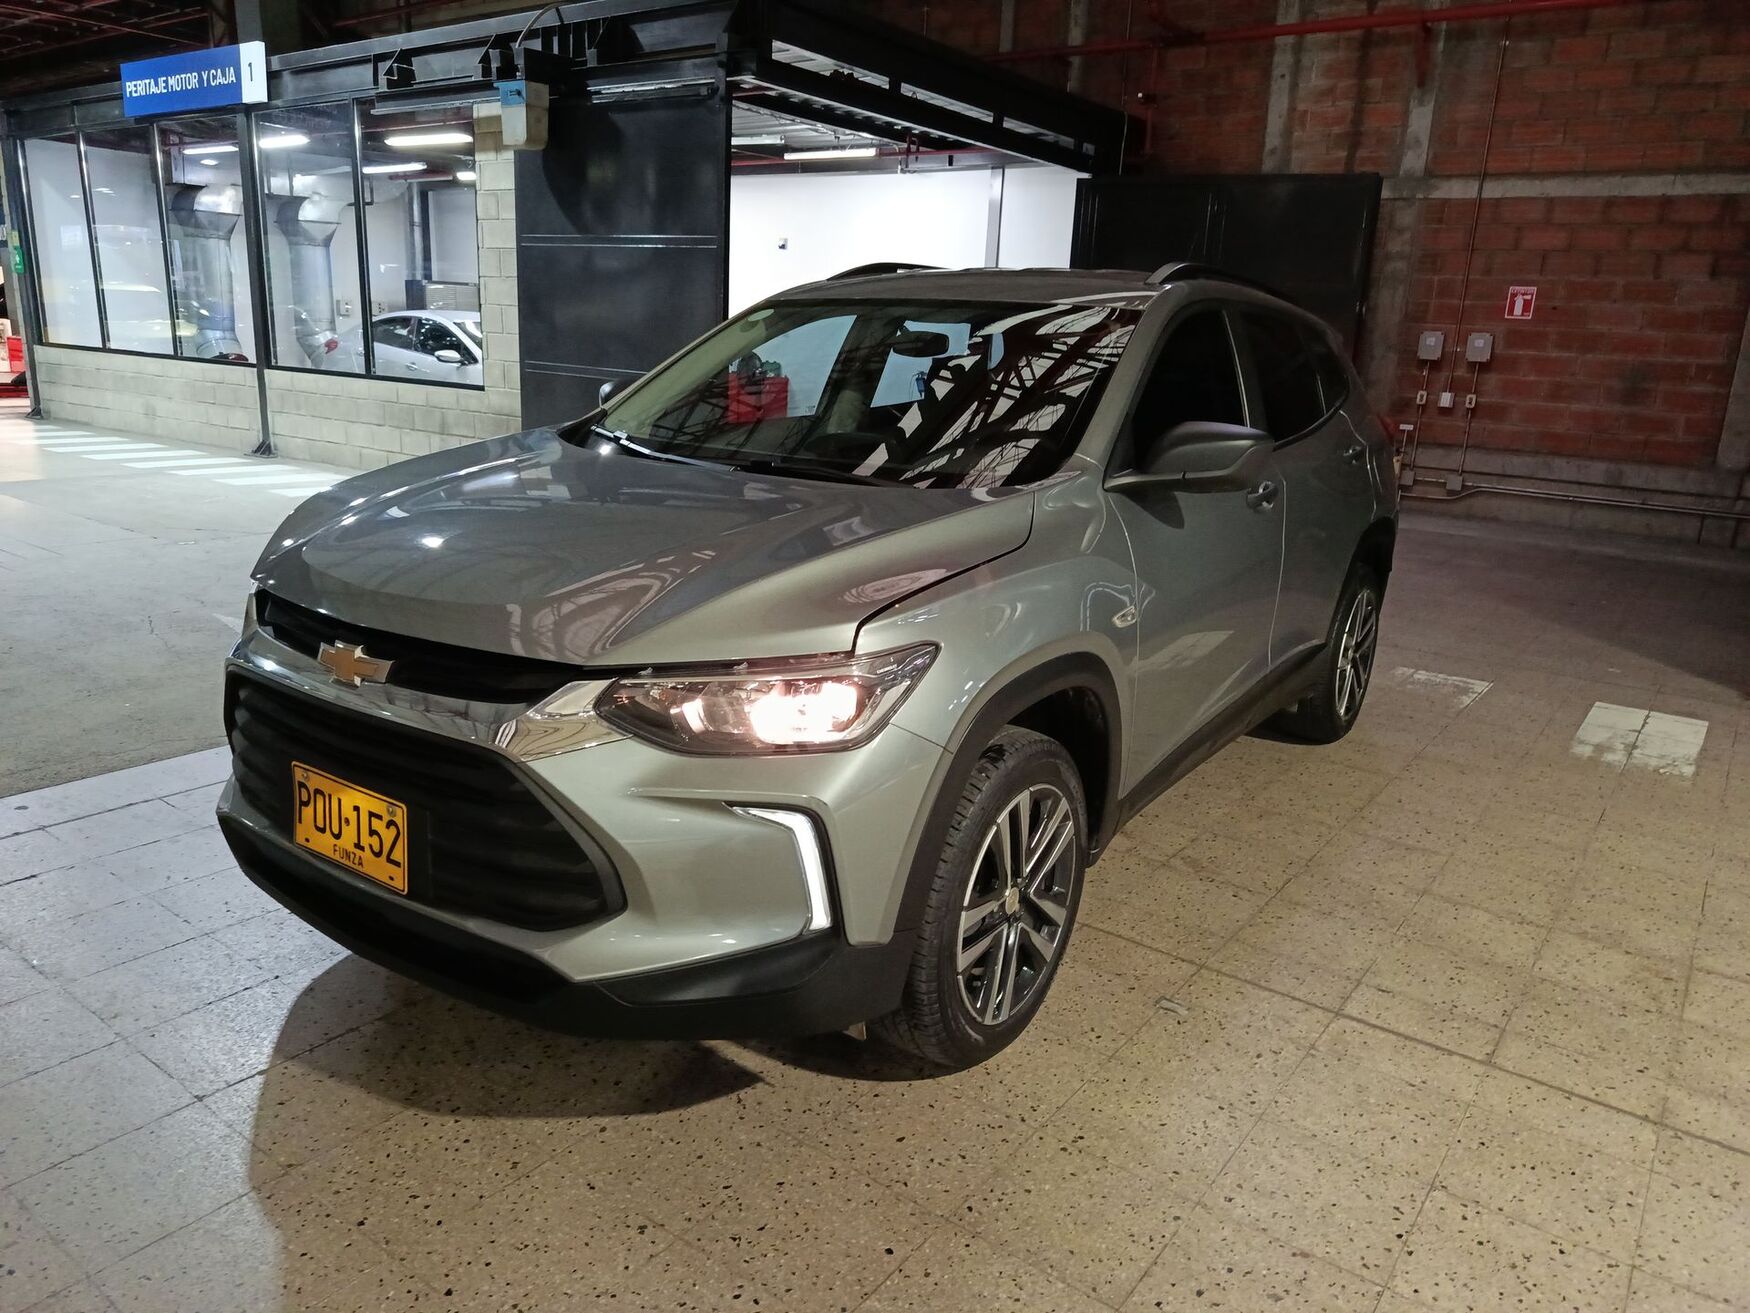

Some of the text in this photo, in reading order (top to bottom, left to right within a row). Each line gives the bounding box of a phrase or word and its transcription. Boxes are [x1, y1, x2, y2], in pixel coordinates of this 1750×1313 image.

[126, 67, 236, 97] PERITAJE MOTOR Y CAJA
[247, 62, 254, 82] 1
[332, 844, 364, 868] FUNZA
